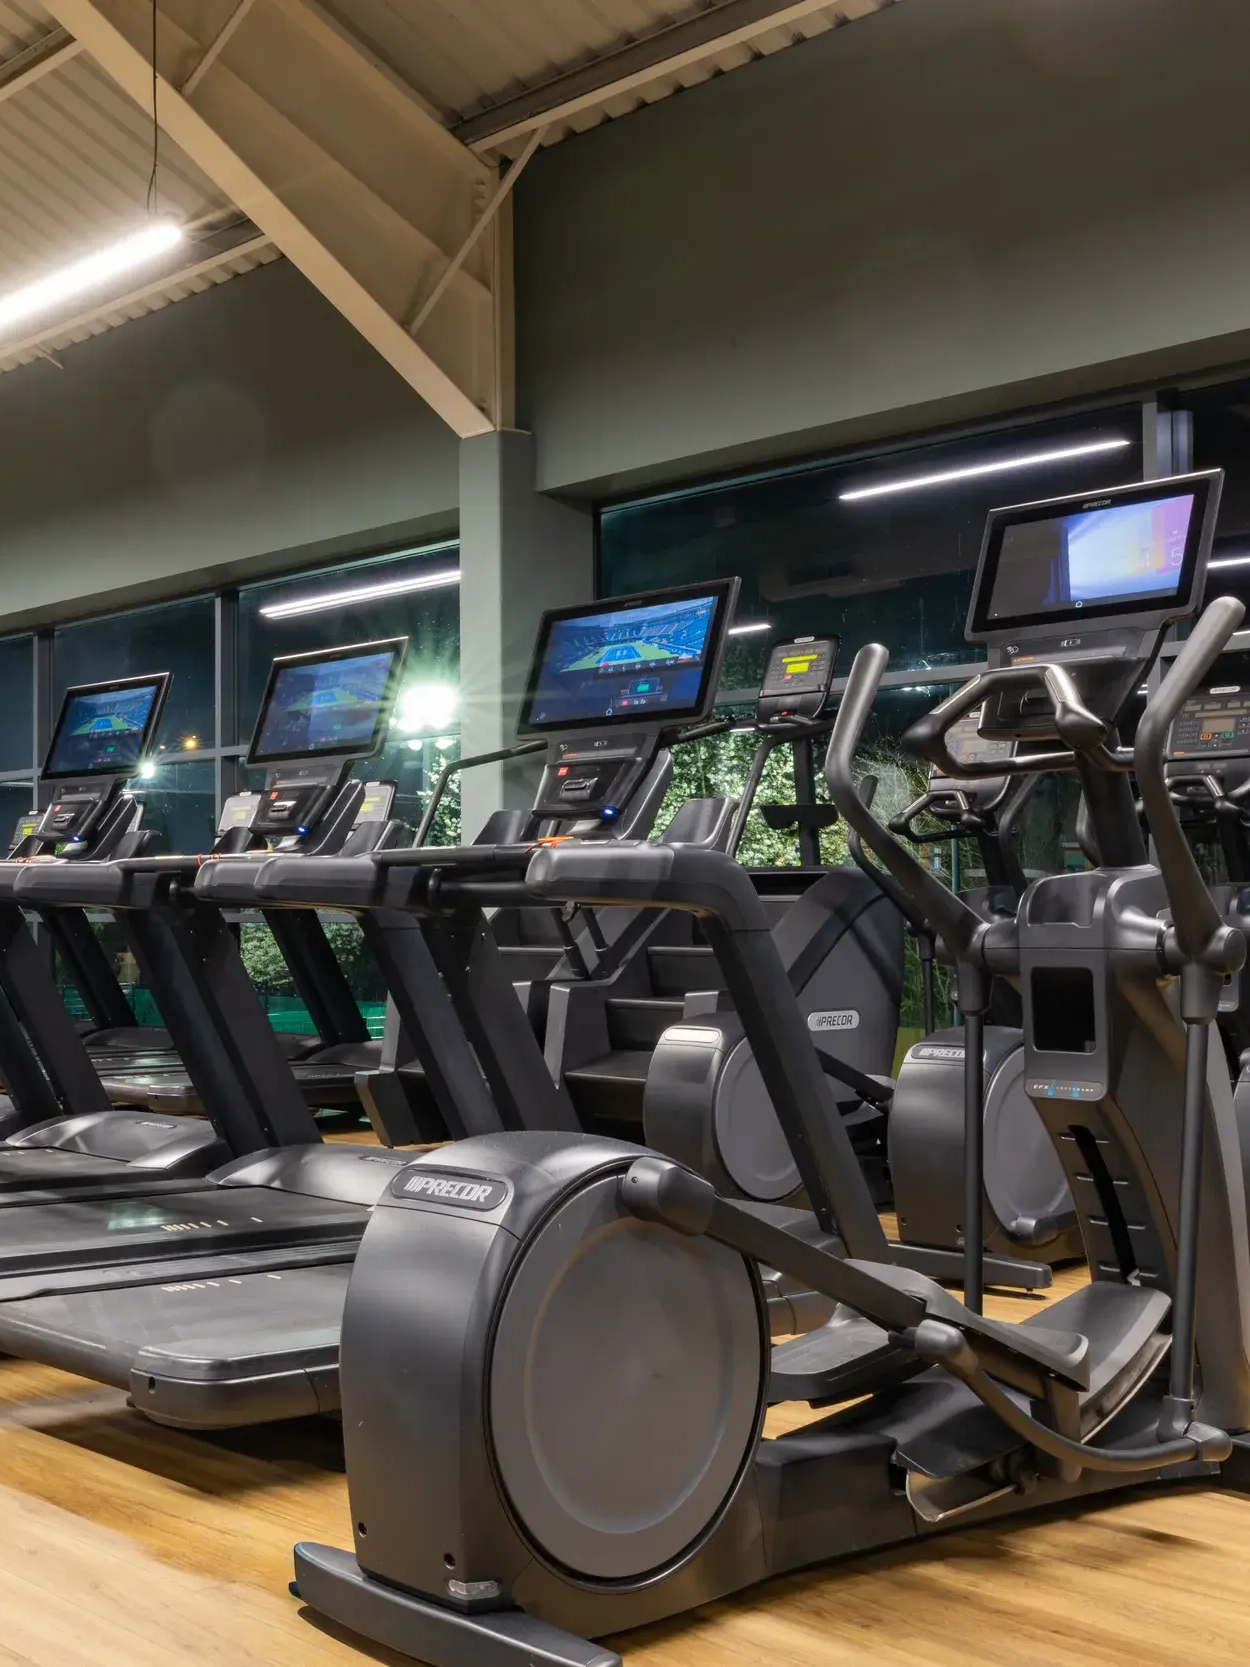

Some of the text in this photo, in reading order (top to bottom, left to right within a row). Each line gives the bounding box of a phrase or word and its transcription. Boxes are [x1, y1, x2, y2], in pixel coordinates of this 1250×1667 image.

[820, 1014, 854, 1027] PRECOR
[925, 1047, 966, 1059] PRECO
[414, 1176, 493, 1203] PRECOR
